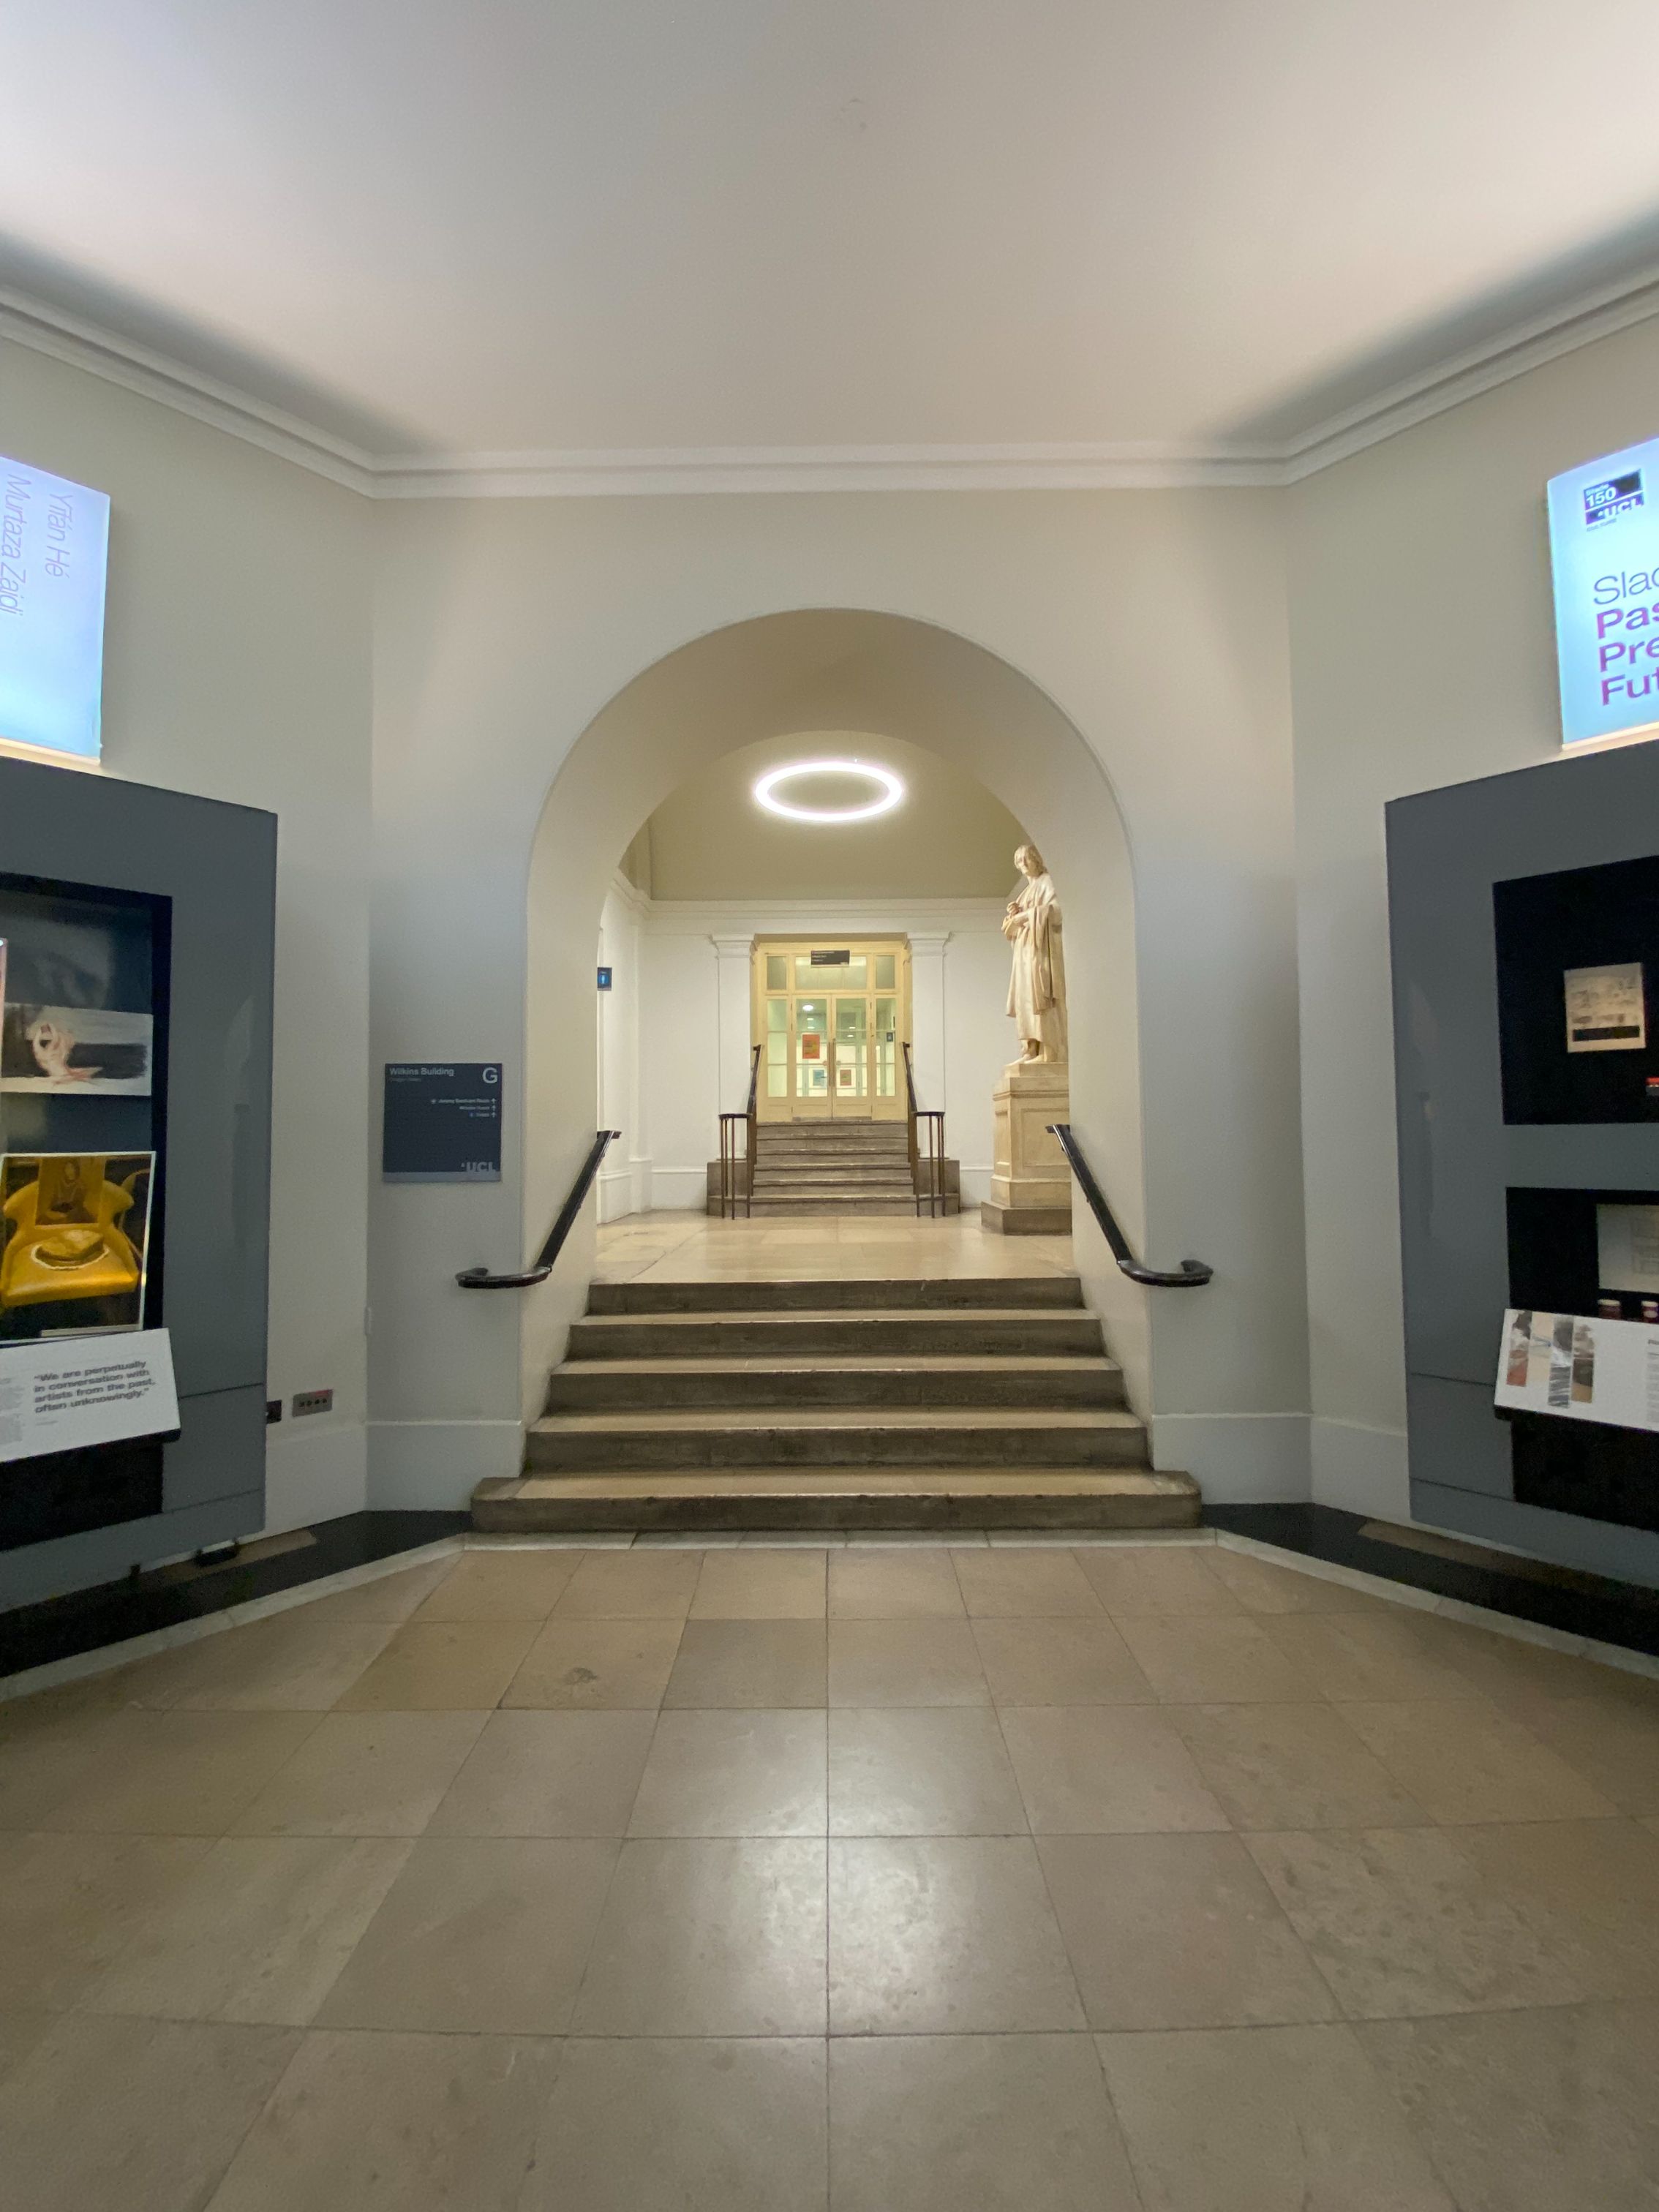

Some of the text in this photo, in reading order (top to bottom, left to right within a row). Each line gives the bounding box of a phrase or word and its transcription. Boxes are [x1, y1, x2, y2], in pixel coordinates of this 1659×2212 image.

[1586, 486, 1617, 507] 150
[1604, 498, 1642, 517] UCL
[0, 474, 31, 616] Murtaza Zaidi
[389, 1067, 454, 1077] Wilkins Building
[482, 1067, 498, 1084] G
[85, 1361, 147, 1376] perpetually
[48, 1374, 124, 1391] conversation
[127, 1369, 150, 1379] with
[34, 1391, 72, 1402] artists
[76, 1386, 104, 1396] from
[108, 1382, 125, 1391] the
[35, 1402, 67, 1413] often
